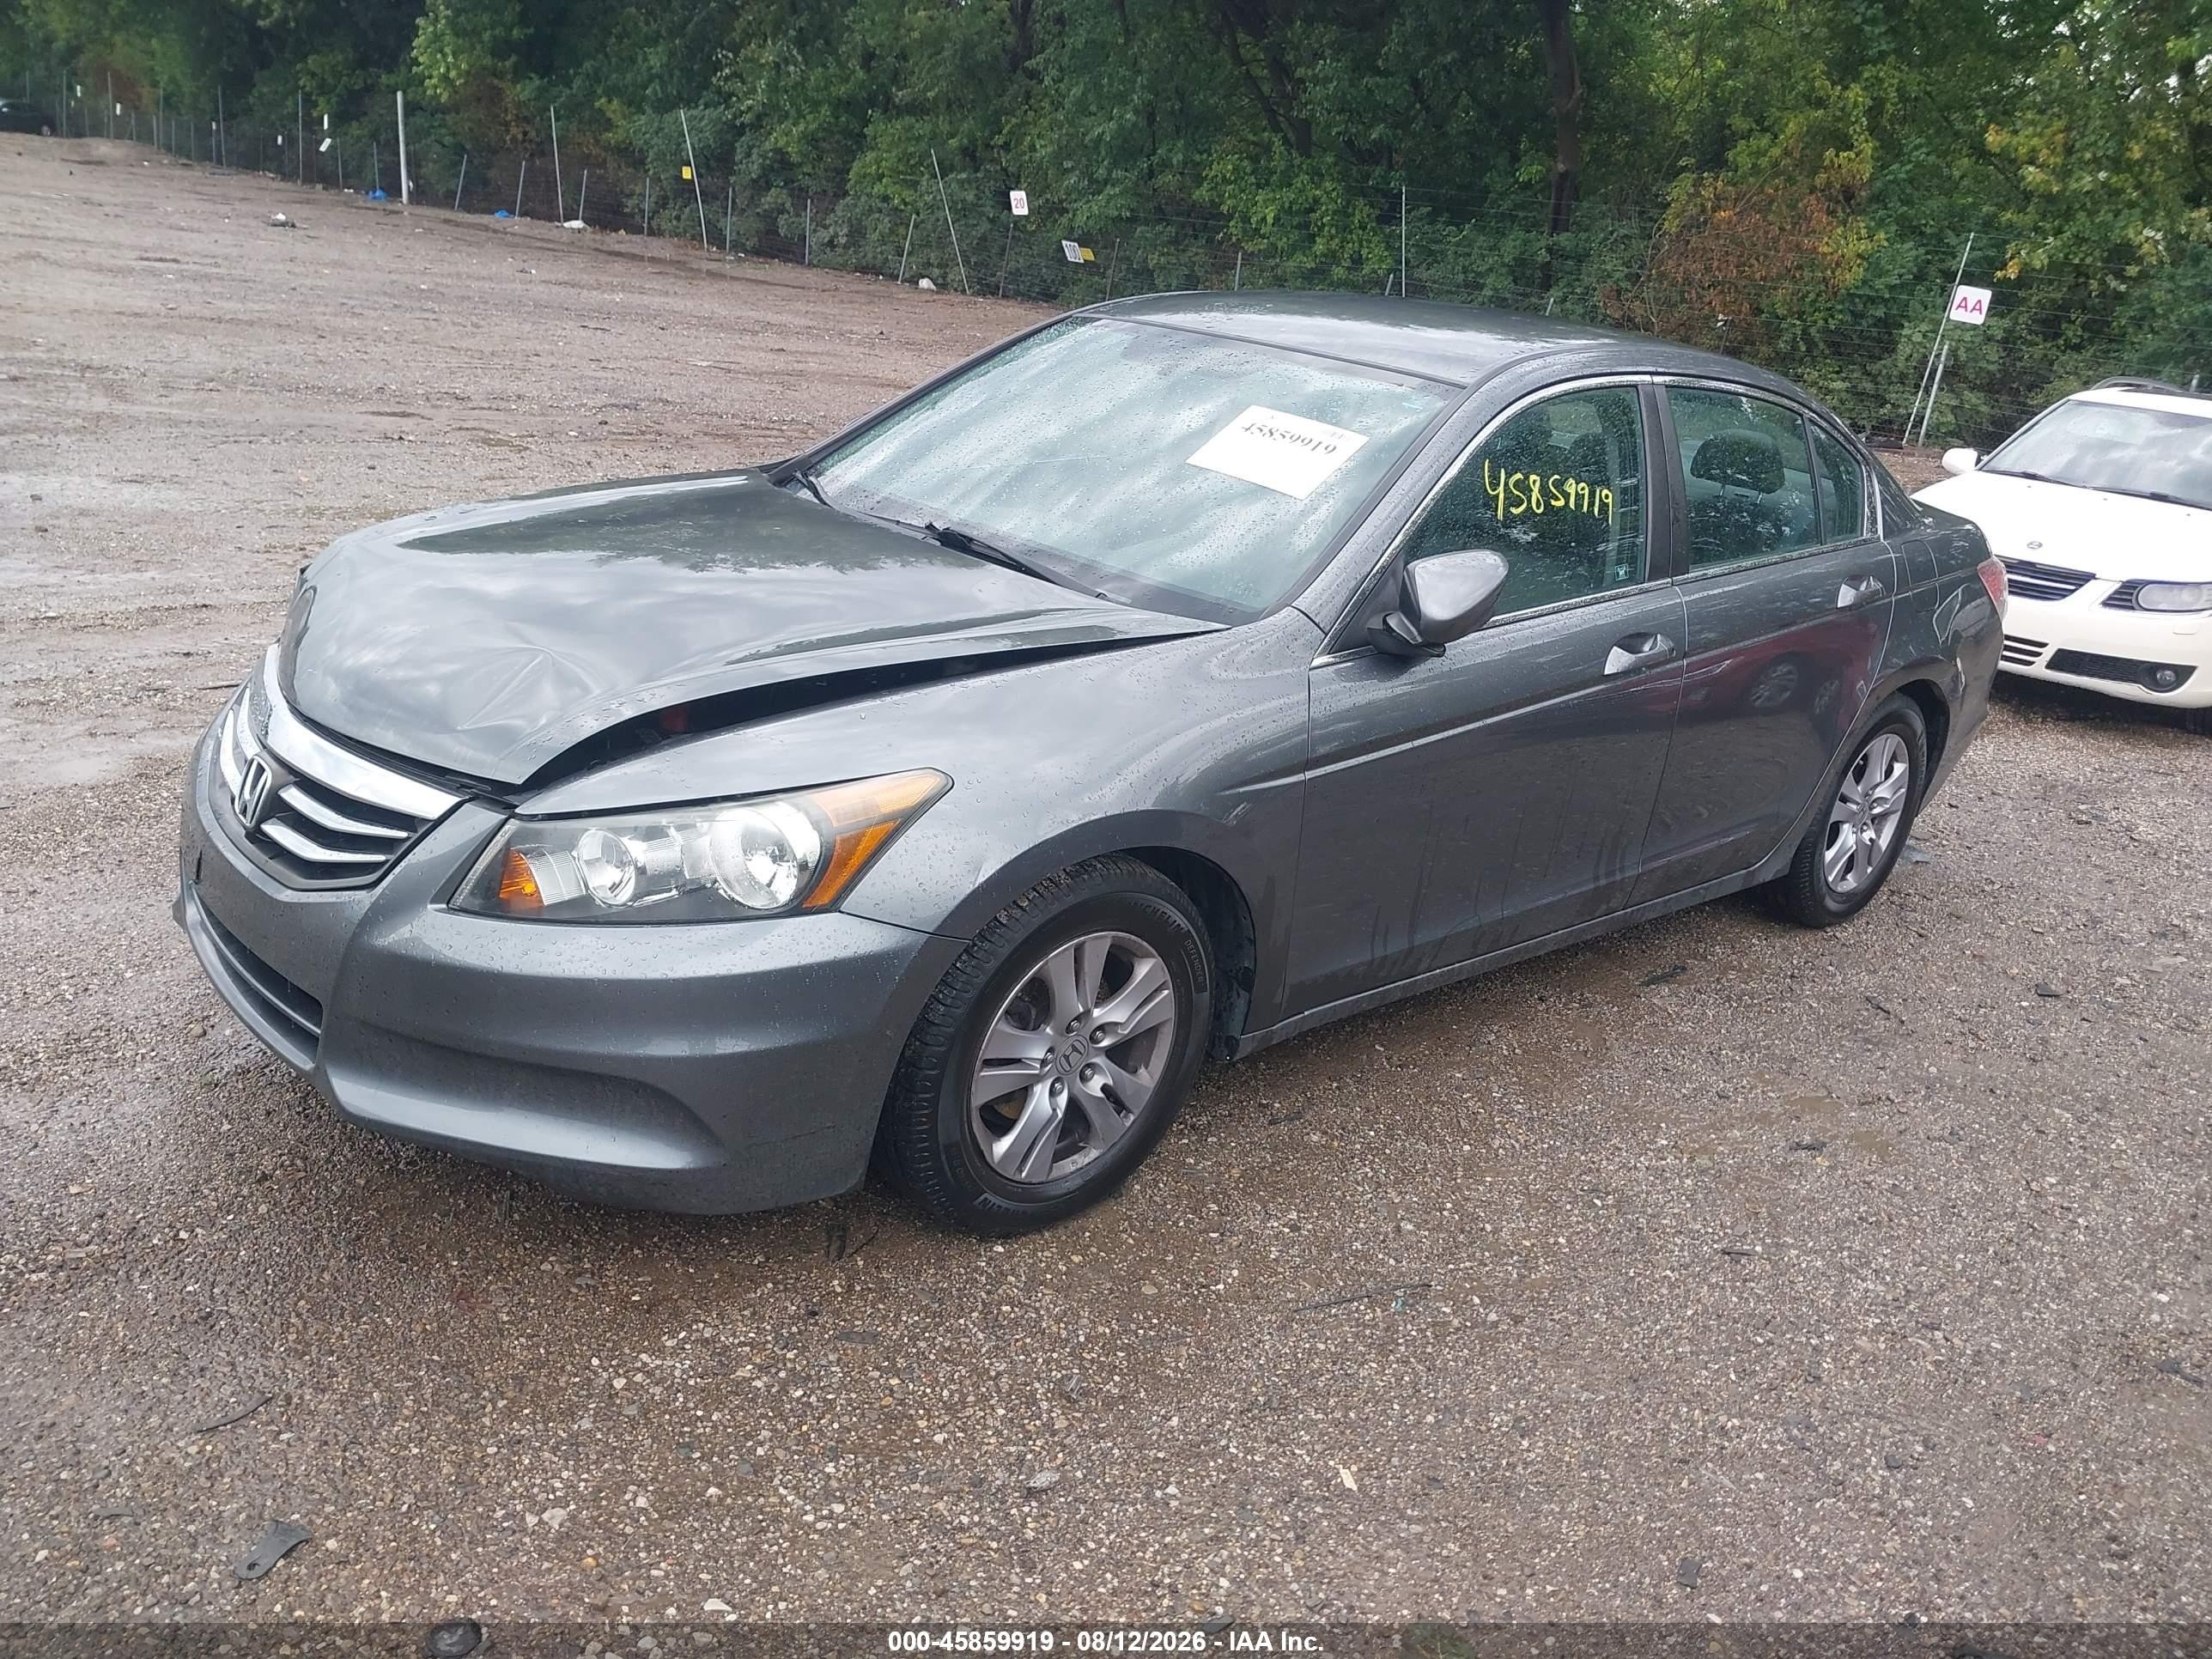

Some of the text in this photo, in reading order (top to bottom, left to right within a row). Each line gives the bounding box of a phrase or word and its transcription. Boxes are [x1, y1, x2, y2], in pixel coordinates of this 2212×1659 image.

[1013, 198, 1025, 209] 20
[1954, 296, 1983, 315] AA
[1241, 422, 1338, 454] 45859919
[1484, 459, 1613, 526] 45859919
